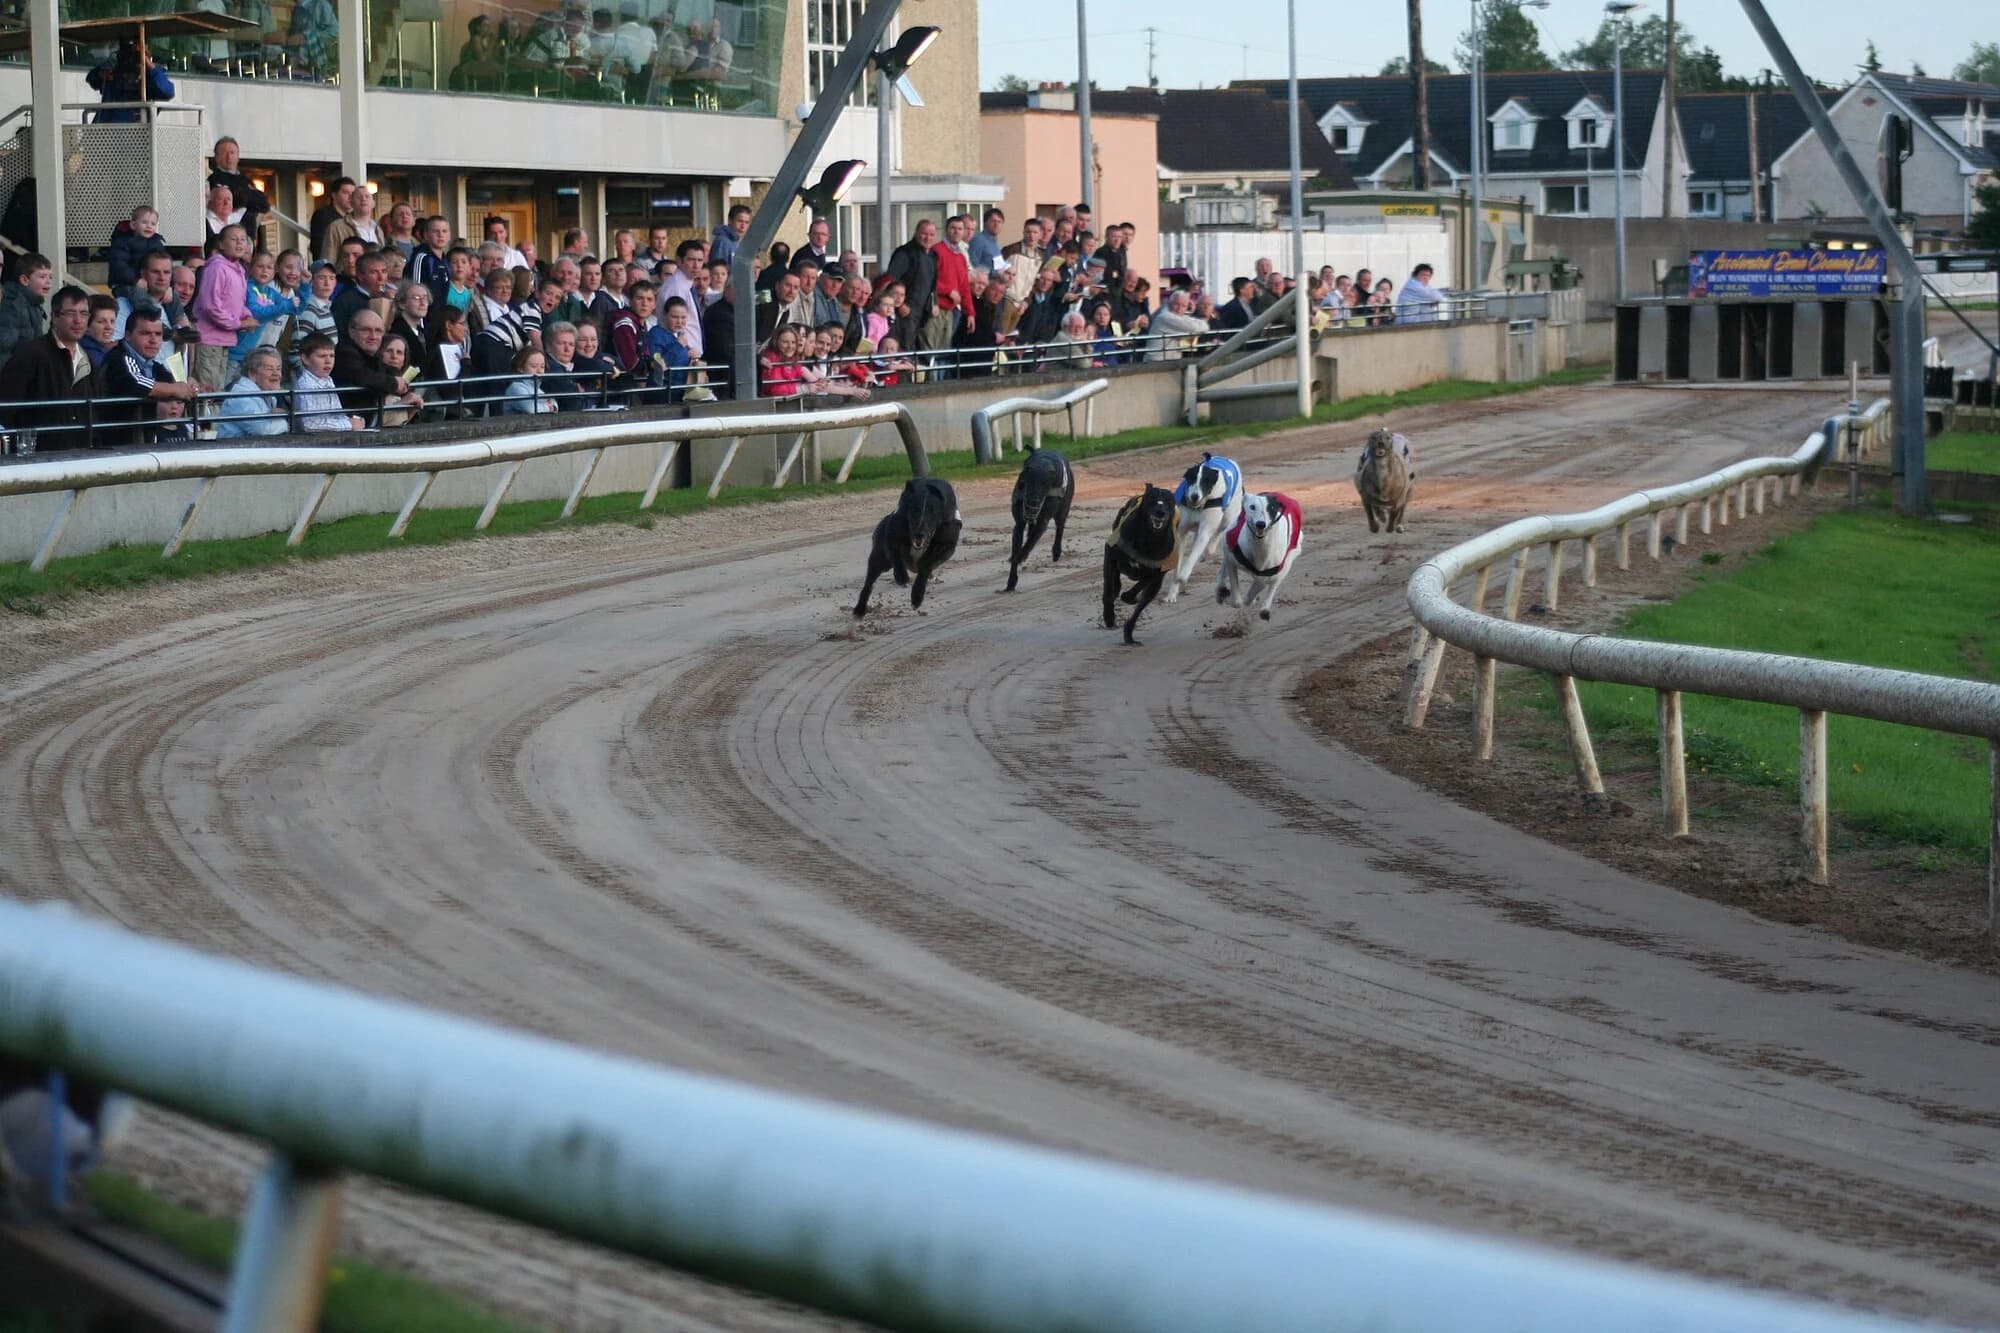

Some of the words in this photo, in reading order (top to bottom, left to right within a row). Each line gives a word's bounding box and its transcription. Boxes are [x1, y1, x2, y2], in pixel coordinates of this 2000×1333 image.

[1774, 250, 1808, 272] Drain
[1808, 250, 1856, 275] Cleaning
[1855, 251, 1880, 271] Ltd.
[1707, 274, 1727, 283] DRAIN
[1728, 274, 1767, 283] MANAGEMENT
[1844, 274, 1880, 283] NATIONWIDE
